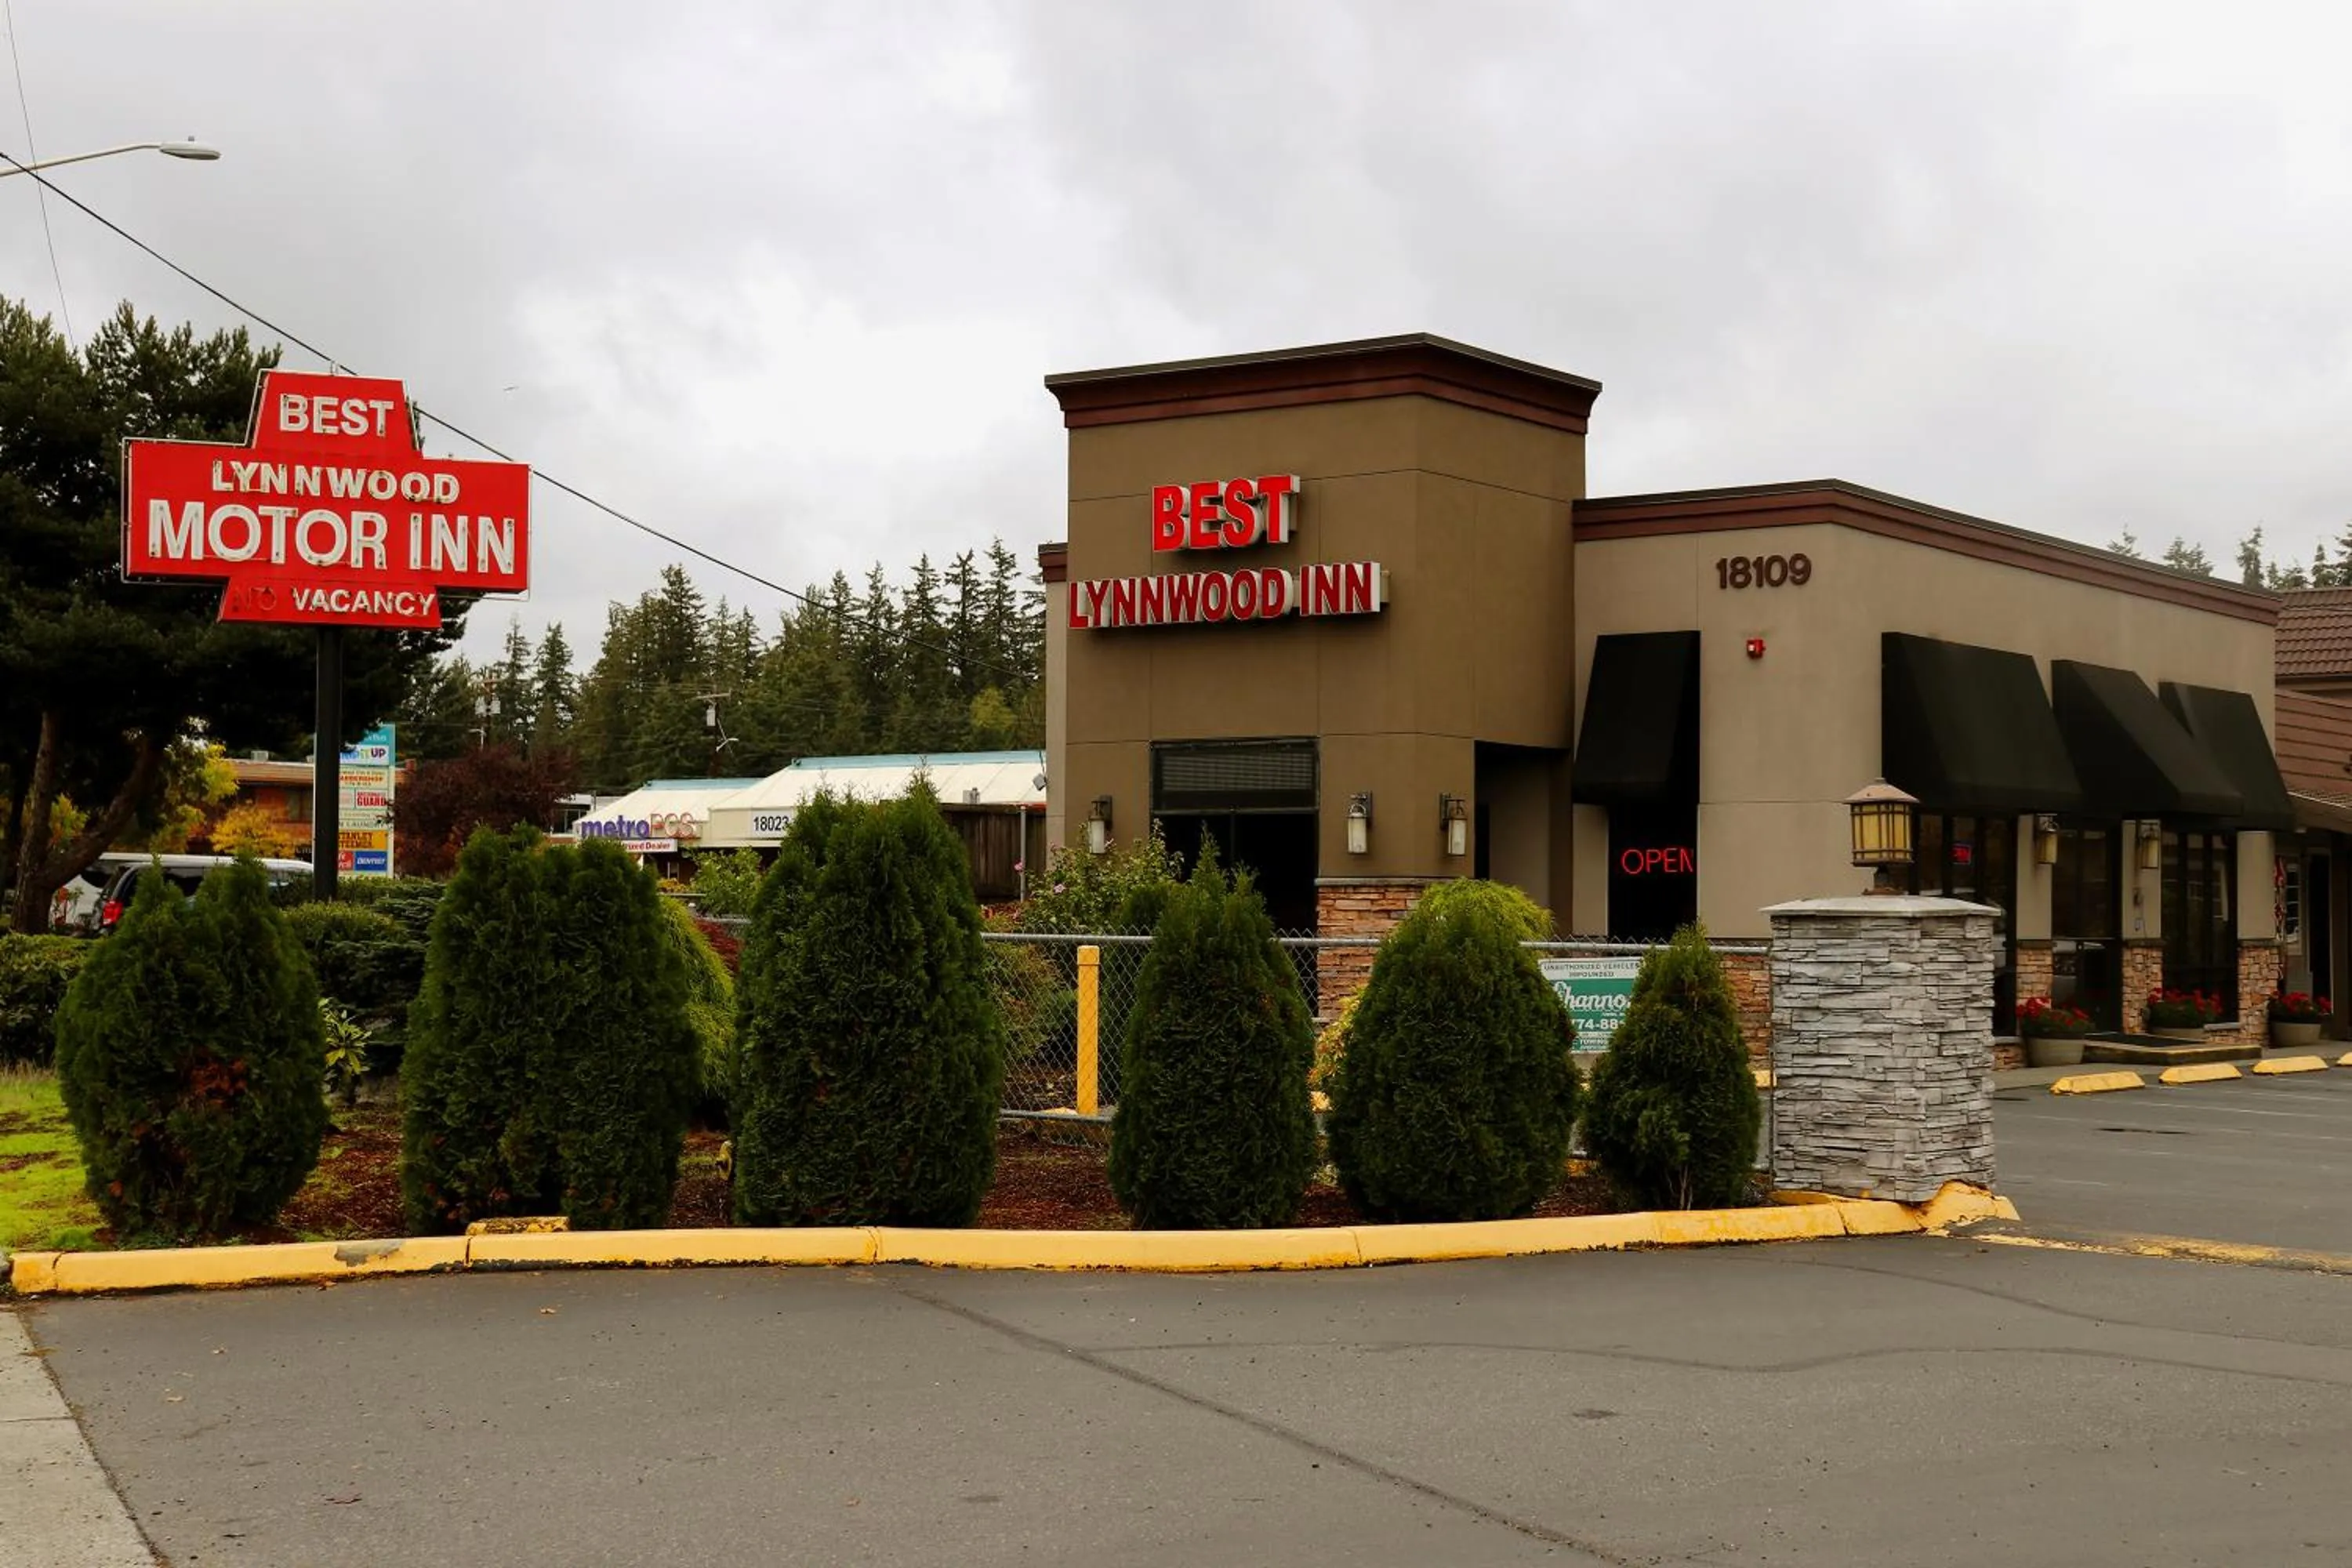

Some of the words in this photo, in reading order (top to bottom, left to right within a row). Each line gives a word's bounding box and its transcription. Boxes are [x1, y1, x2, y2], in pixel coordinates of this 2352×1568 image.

[279, 393, 394, 437] BEST
[212, 459, 461, 505] LYNNWOOD
[1152, 474, 1301, 553] BEST
[148, 499, 388, 570] MOTOR
[408, 513, 516, 575] INN
[1715, 553, 1812, 590] 18109
[292, 586, 436, 616] VACANCY
[1069, 568, 1294, 630] LYNNWOOD
[1299, 561, 1381, 616] INN
[581, 812, 695, 840] metroPCS
[1621, 848, 1694, 874] OPEN
